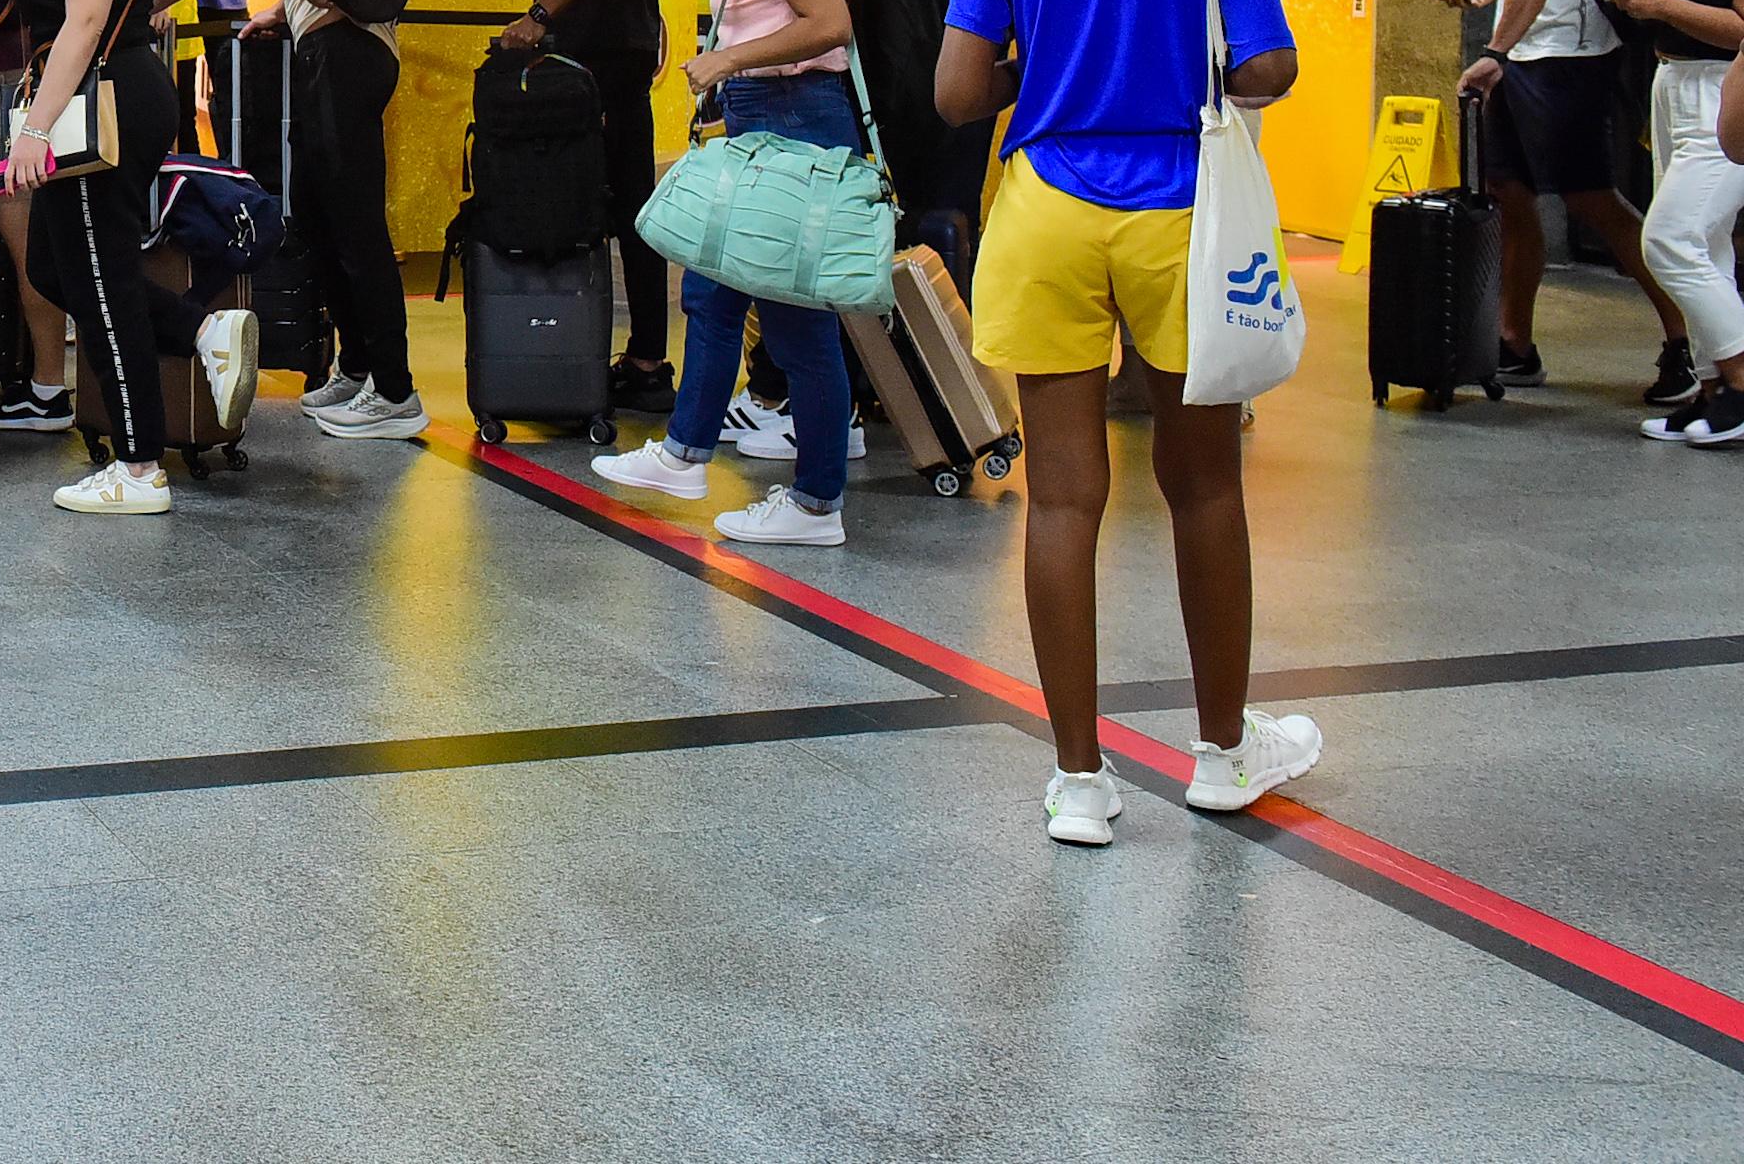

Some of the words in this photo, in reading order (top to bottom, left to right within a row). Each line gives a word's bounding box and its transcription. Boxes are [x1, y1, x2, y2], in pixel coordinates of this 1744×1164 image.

[1383, 135, 1423, 147] CUIDADO
[1226, 308, 1234, 324] É
[1238, 313, 1260, 329] tão
